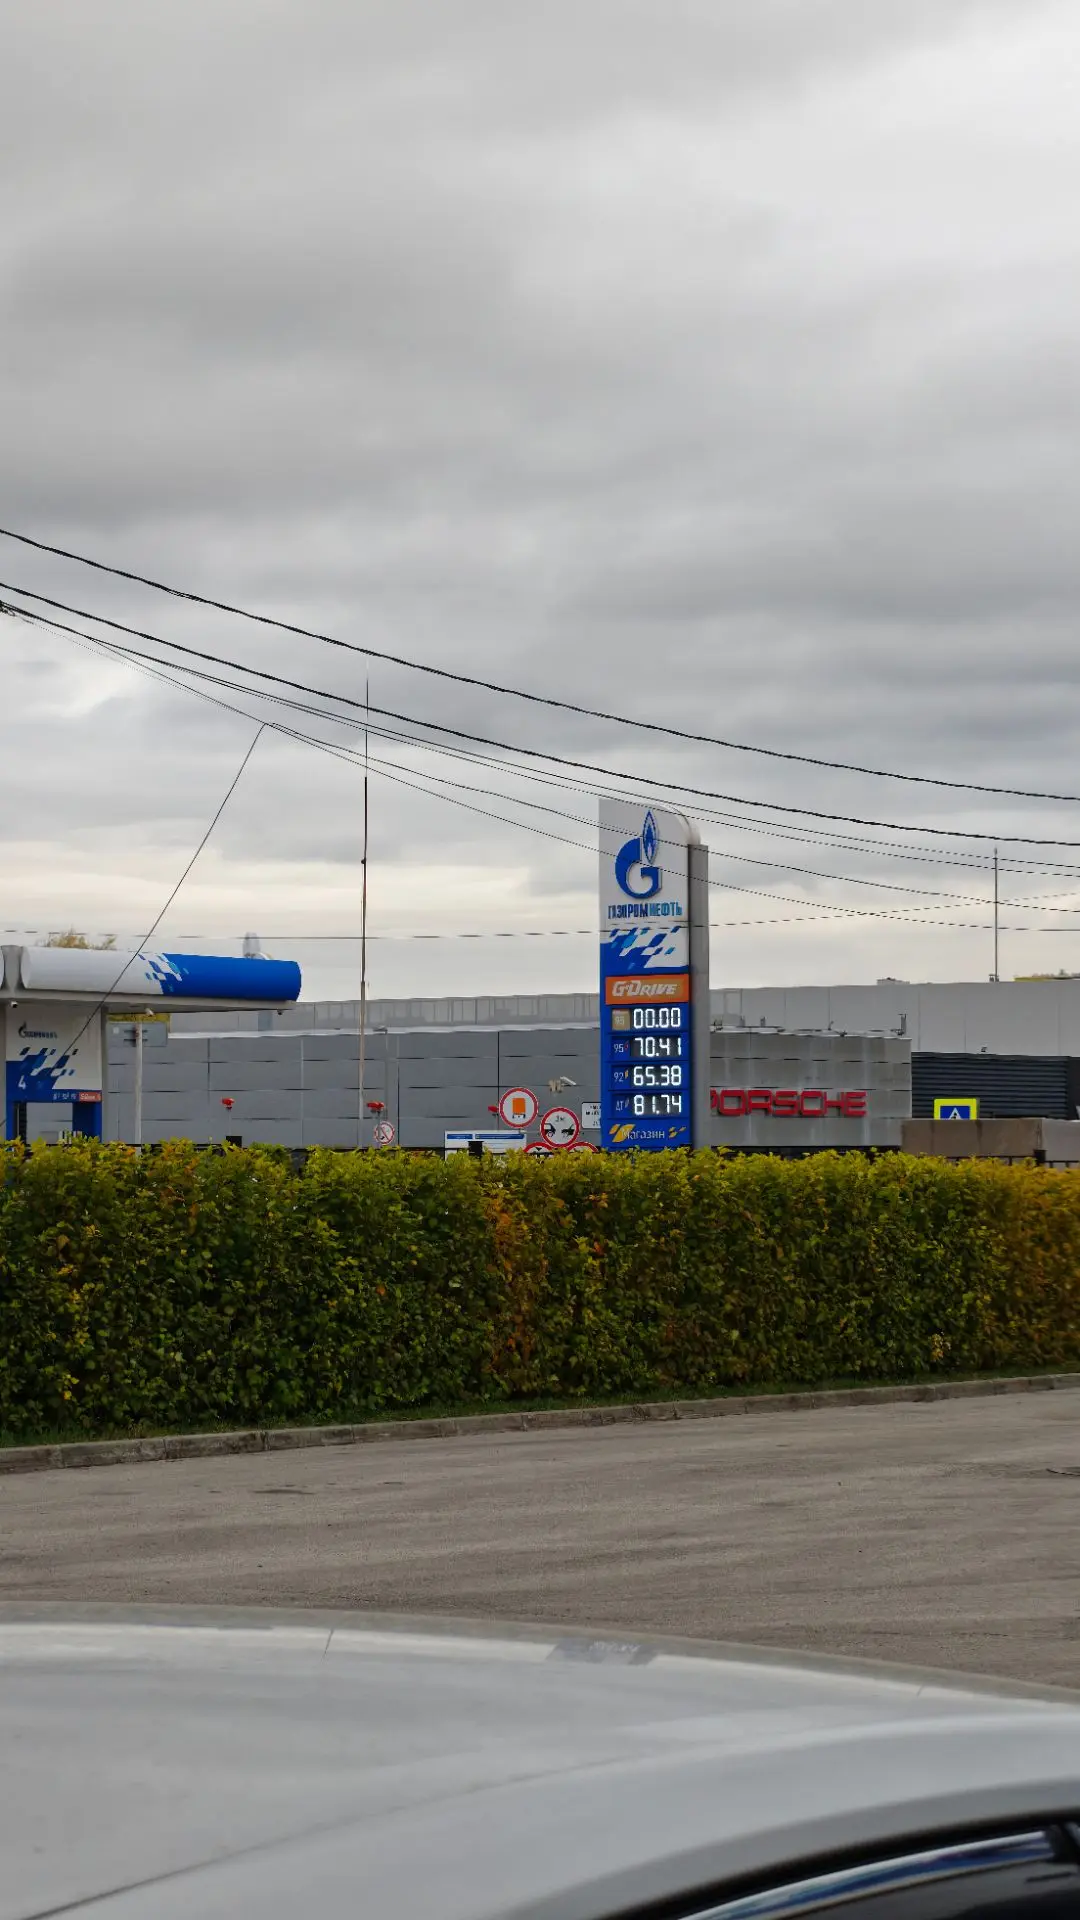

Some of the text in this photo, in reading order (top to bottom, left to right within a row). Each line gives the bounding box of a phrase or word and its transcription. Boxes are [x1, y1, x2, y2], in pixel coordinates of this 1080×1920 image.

[608, 902, 683, 919] ГАЗПРОМНЕФТЬ
[634, 1008, 681, 1029] 00.00
[614, 1037, 681, 1057] 95 70.41
[18, 1074, 27, 1089] 4
[614, 1065, 682, 1086] 92 65.38
[616, 1094, 682, 1116] ДТ 81.74
[710, 1088, 867, 1117] ORSCHE
